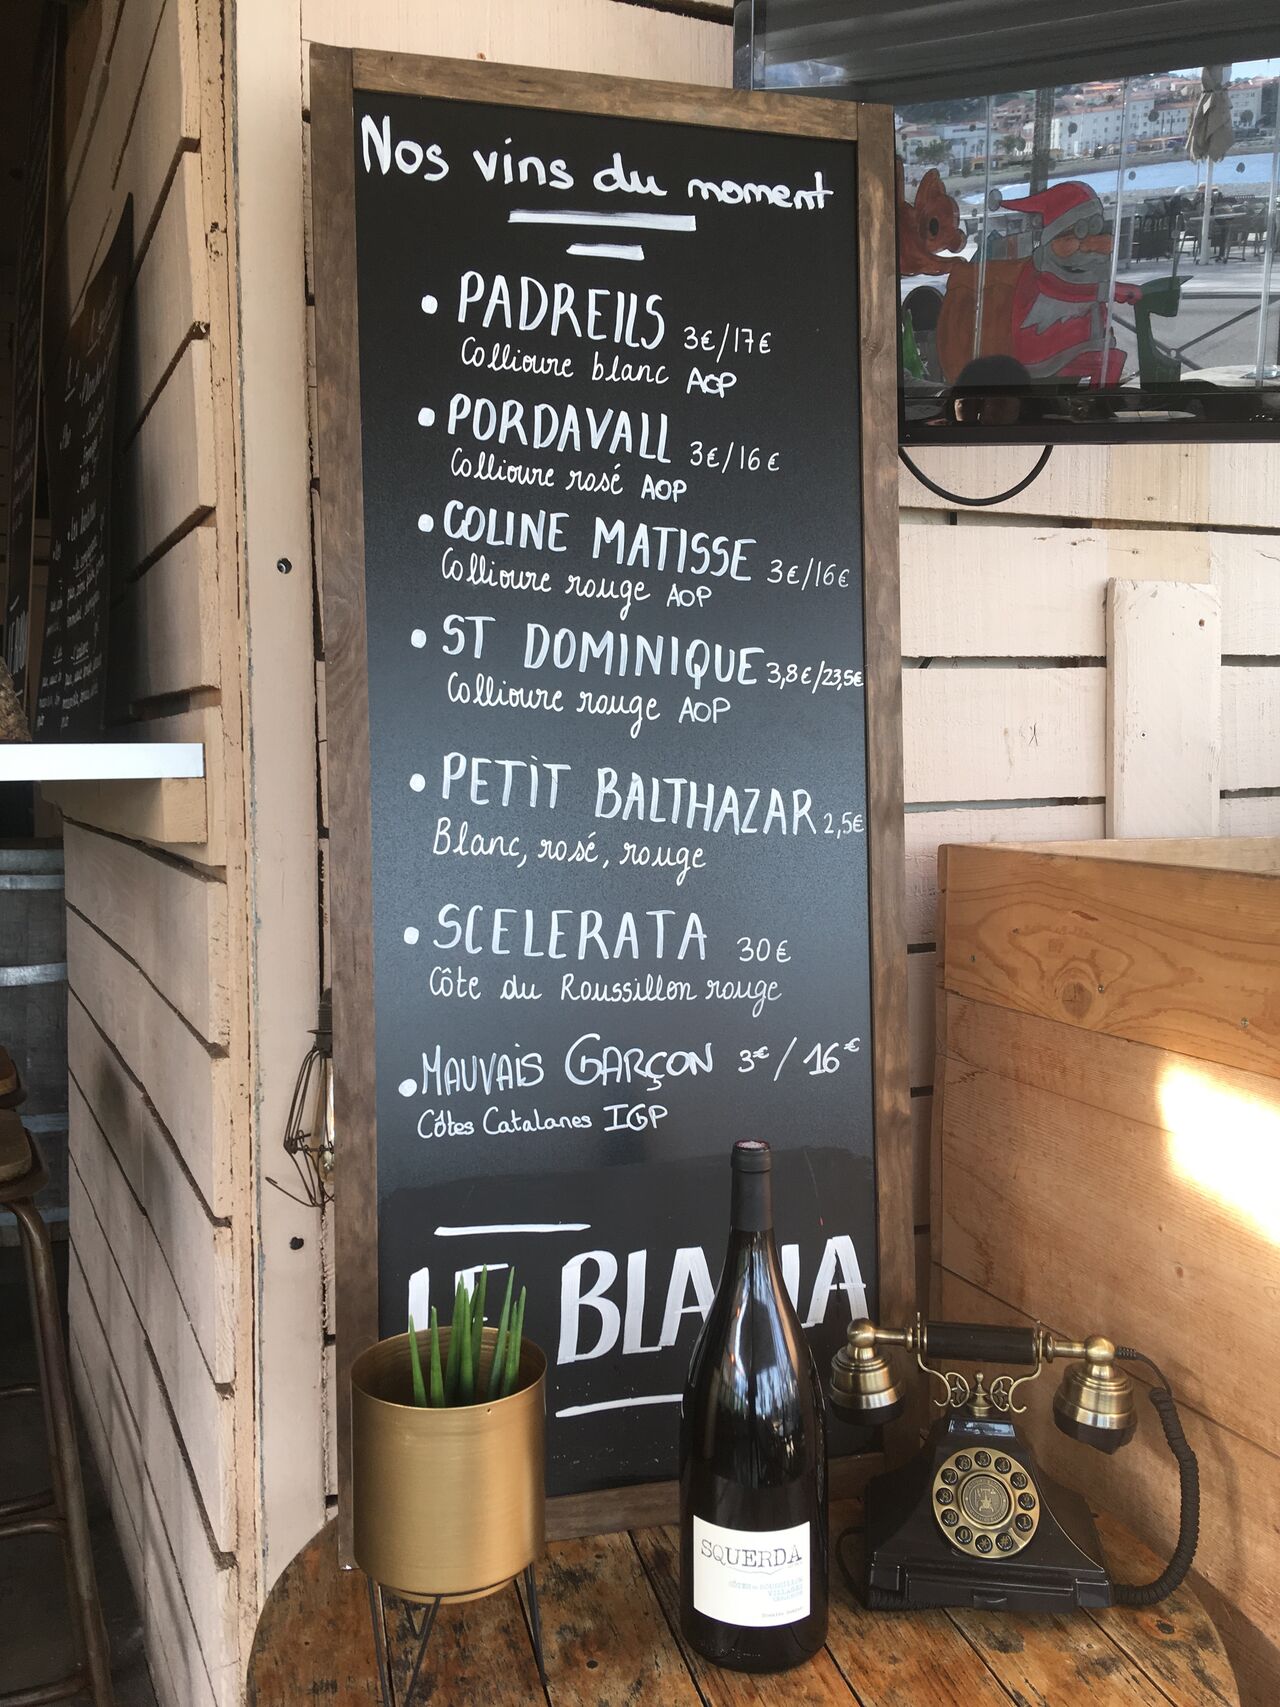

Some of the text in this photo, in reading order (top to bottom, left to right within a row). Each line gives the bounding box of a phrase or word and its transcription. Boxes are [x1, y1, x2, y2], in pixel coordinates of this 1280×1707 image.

[360, 114, 835, 211] Nos vins du moment
[457, 270, 665, 352] PADREILS
[461, 336, 738, 399] Collioure blanc AOP
[447, 393, 672, 465] PORDAVALL
[450, 445, 688, 503] Collioure rosé AOP
[443, 499, 570, 554] COLINE
[592, 516, 757, 583] MATISSE
[441, 545, 553, 593] Collioure
[564, 576, 651, 621] rouge
[442, 614, 496, 659] ST
[523, 622, 765, 690] DOMINIQUE
[447, 671, 564, 713] Collioure
[575, 691, 661, 739] rouge
[594, 766, 817, 836] BALTHAZAR
[823, 811, 865, 840] 2,5€
[432, 816, 707, 887] Blanc, rosé, rouge
[432, 903, 792, 963] SCELERATA 30€
[429, 965, 783, 1018] Côte du Roussillon rouge
[564, 1032, 713, 1092] GARÇON
[417, 1103, 668, 1139] Côtes Catalanes IGP
[700, 1538, 803, 1568] SQUERDA
